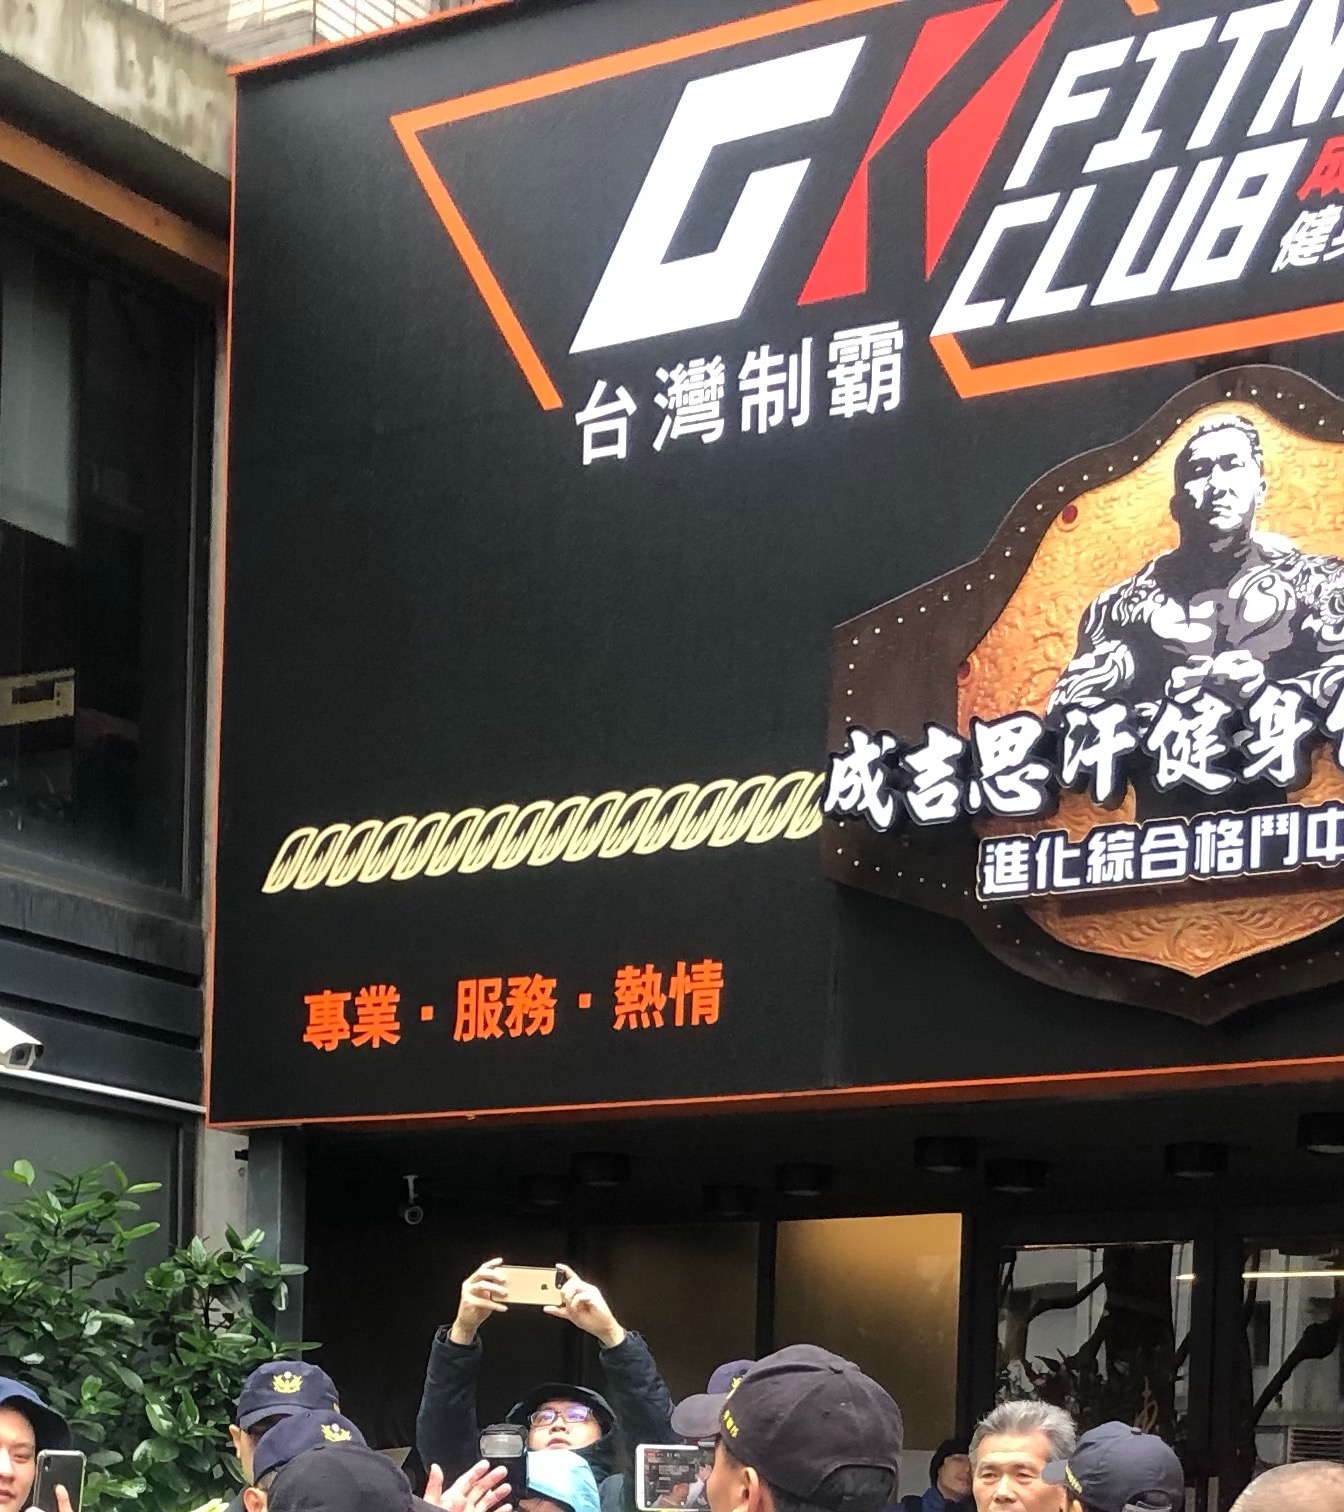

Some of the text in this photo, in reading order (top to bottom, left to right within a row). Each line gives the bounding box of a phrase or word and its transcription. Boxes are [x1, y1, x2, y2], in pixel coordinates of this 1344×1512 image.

[569, 0, 1057, 354] GK
[930, 142, 1308, 337] CLUB
[574, 320, 904, 467] 台灣制霸
